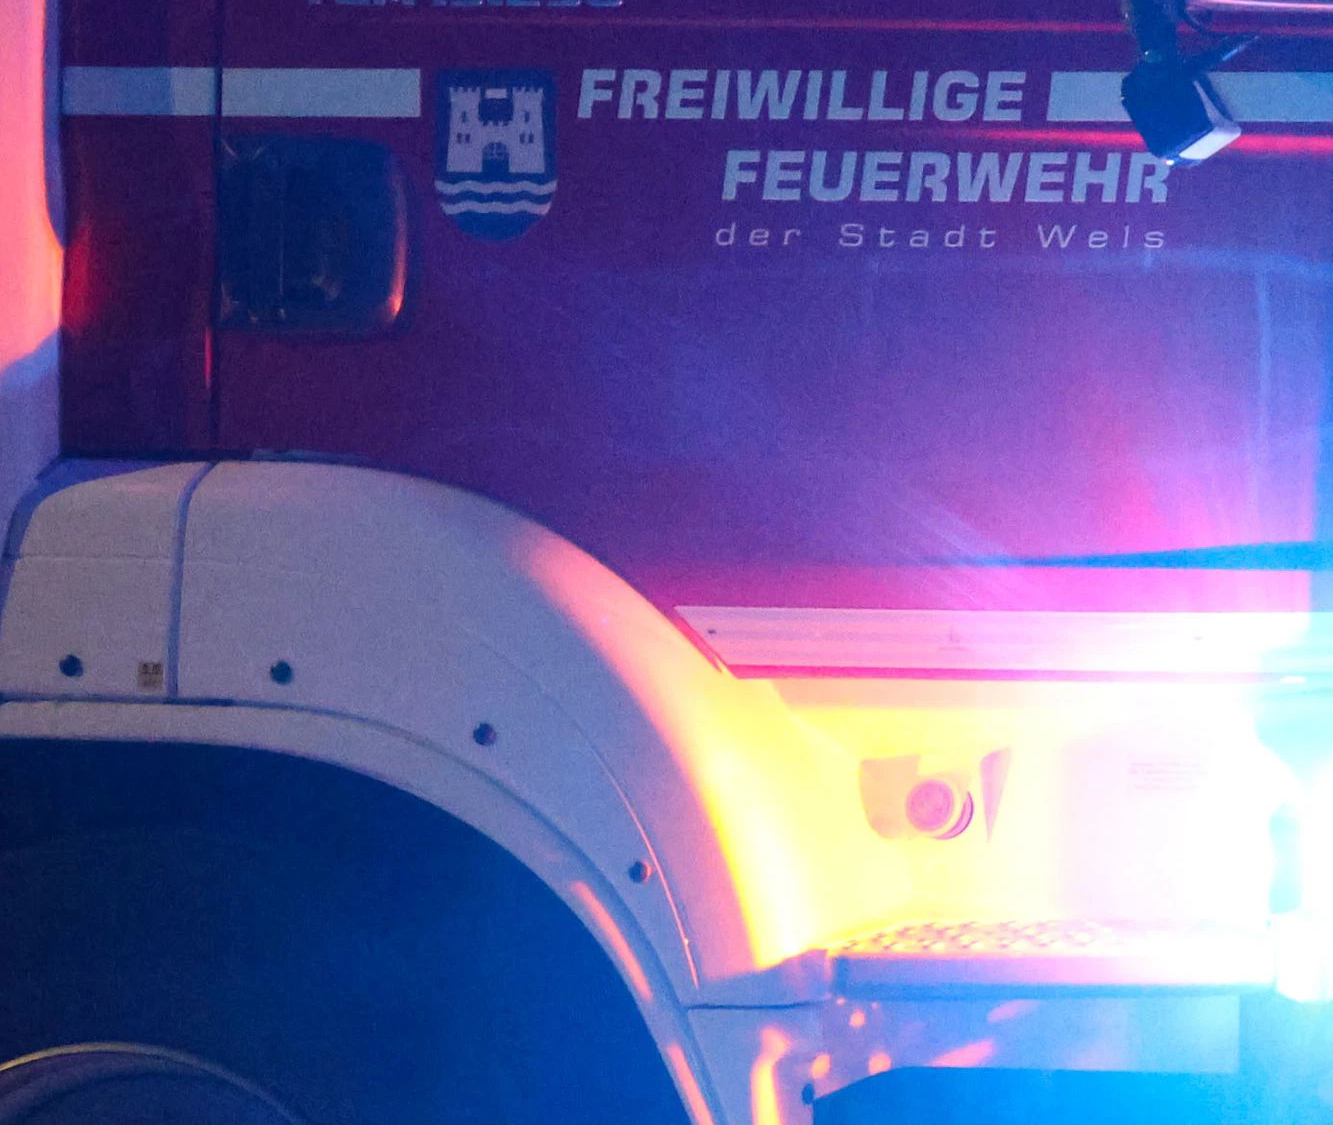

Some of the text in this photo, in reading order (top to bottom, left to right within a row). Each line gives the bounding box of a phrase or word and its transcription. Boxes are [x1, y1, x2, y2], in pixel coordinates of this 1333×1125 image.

[577, 69, 1026, 121] FREIWILLIGE
[722, 150, 1170, 203] FEUERWEHR
[715, 222, 1165, 251] der Stadt Wels
